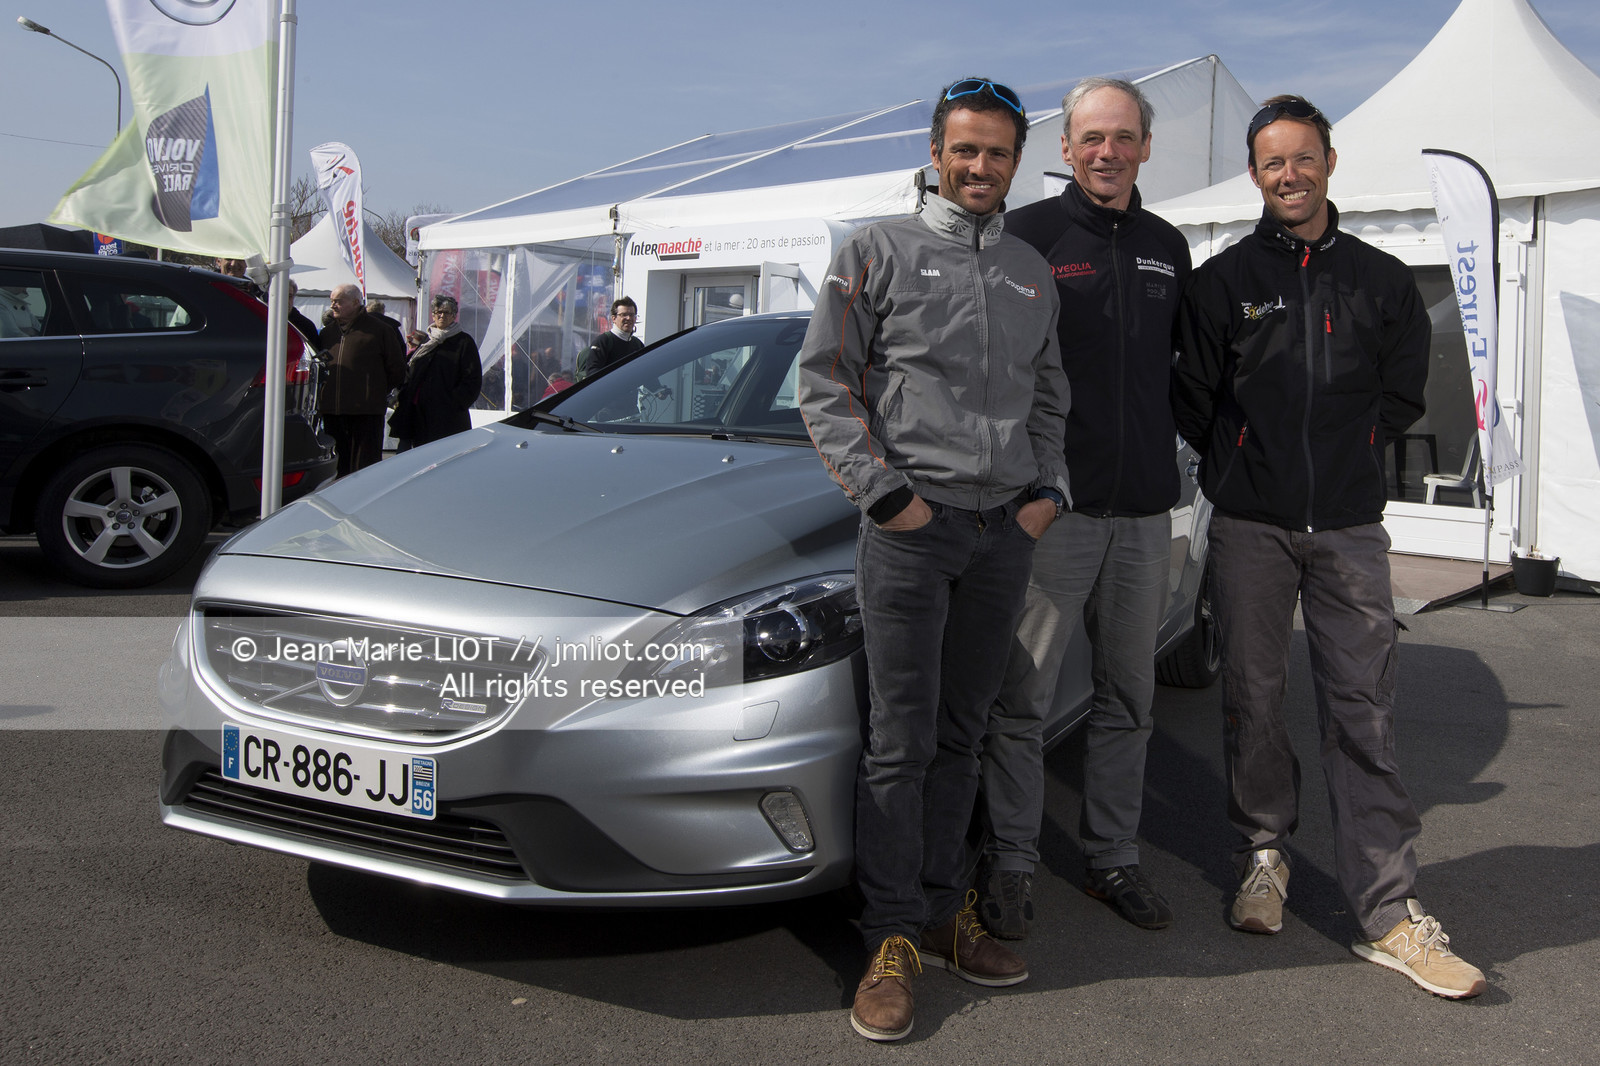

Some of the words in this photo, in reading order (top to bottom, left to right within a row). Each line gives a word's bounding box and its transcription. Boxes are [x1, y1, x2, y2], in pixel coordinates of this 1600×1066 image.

[630, 238, 702, 261] Intermarché
[704, 243, 713, 252] et
[715, 242, 722, 251] la
[724, 242, 740, 251] mer
[747, 237, 759, 249] 20
[761, 238, 776, 249] ans
[777, 236, 789, 248] de
[791, 234, 826, 249] passion
[920, 268, 941, 277] SLAM
[1056, 262, 1092, 273] VEOLIA
[1243, 301, 1274, 319] Sodebo
[319, 666, 362, 682] VOLVO
[228, 757, 234, 769] F
[244, 735, 409, 806] CR-886-JJ
[414, 788, 433, 811] 56
